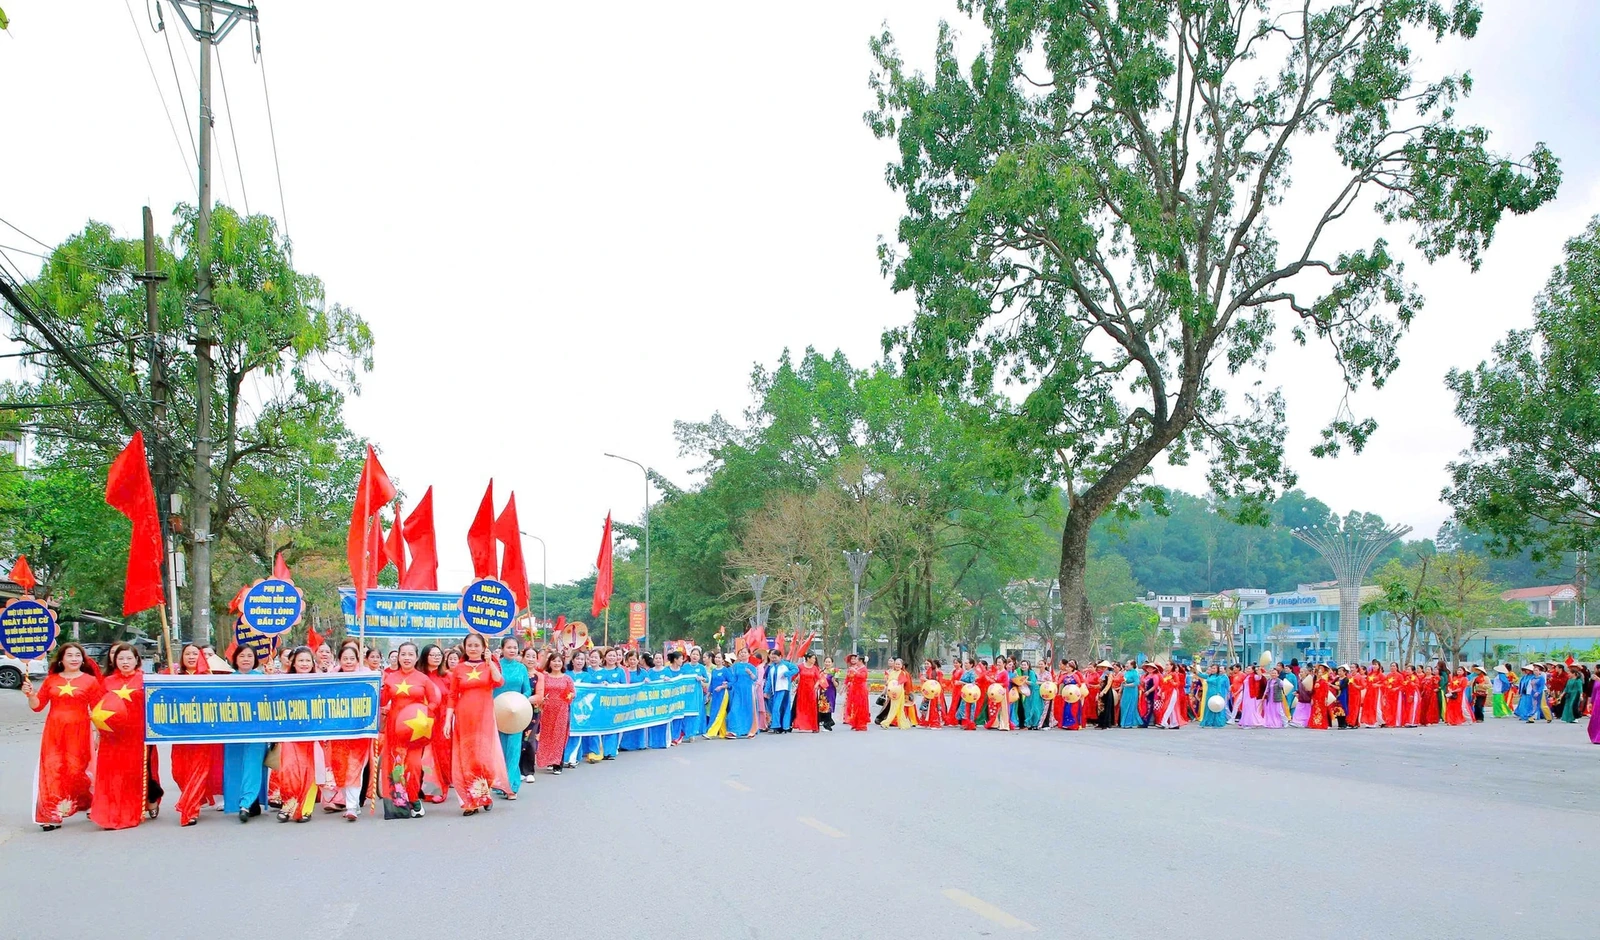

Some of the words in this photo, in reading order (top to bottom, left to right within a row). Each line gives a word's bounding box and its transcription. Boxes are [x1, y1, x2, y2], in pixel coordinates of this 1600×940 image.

[481, 585, 501, 594] NGÀY
[377, 601, 392, 610] PHỤ
[395, 600, 407, 609] NỮ
[408, 601, 440, 610] PHƯỜNG
[1276, 596, 1316, 605] vinaphone
[2, 618, 21, 626] NGÀY
[38, 615, 49, 624] CỬ
[275, 617, 287, 625] CỬ
[154, 696, 167, 724] MỖI
[169, 698, 179, 724] LÁ
[179, 696, 201, 724] PHIẾU
[202, 698, 218, 727] MỘT
[239, 702, 252, 722] TIN
[257, 694, 272, 721] MỖI
[273, 699, 287, 726] LỰA
[288, 700, 310, 724] CHỌN,
[311, 694, 326, 724] MỘT
[327, 694, 349, 718] TRÁCH
[351, 693, 372, 721] NHIỆM
